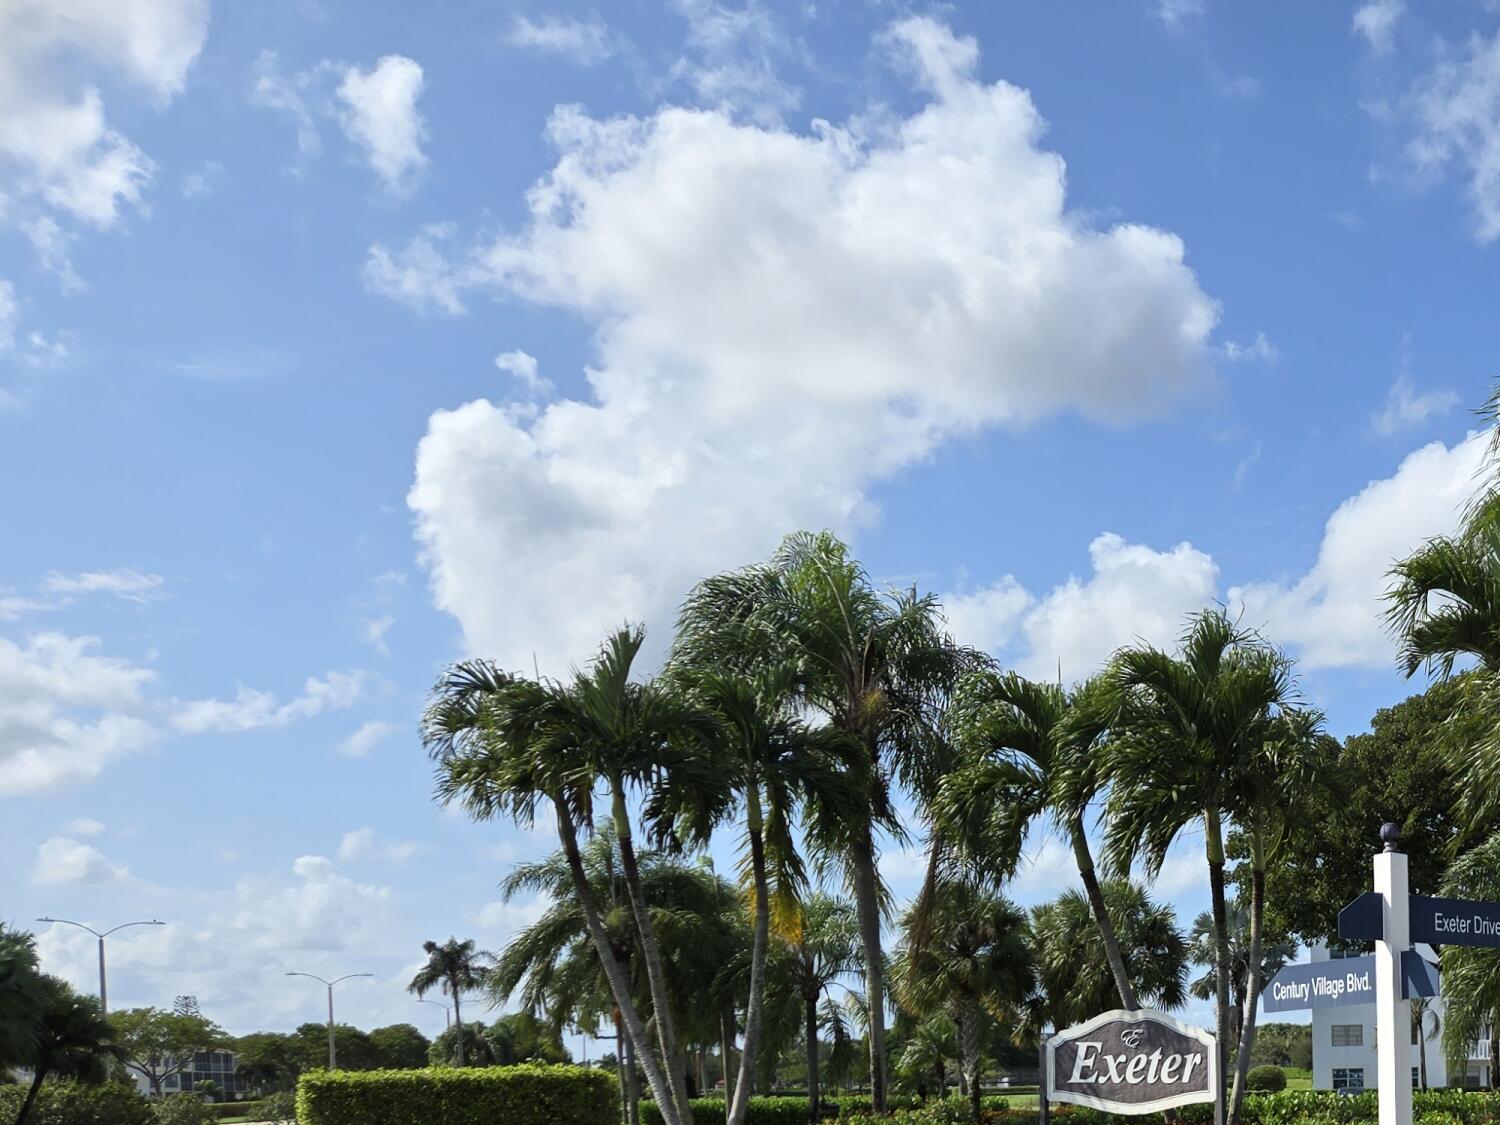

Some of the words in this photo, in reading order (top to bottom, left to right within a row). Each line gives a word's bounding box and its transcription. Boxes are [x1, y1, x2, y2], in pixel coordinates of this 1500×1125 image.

[1434, 912, 1471, 933] Exeter
[1273, 981, 1310, 1002] Century
[1311, 975, 1344, 999] Village
[1346, 971, 1372, 992] Blvd.
[1066, 1041, 1202, 1084] Exeter
